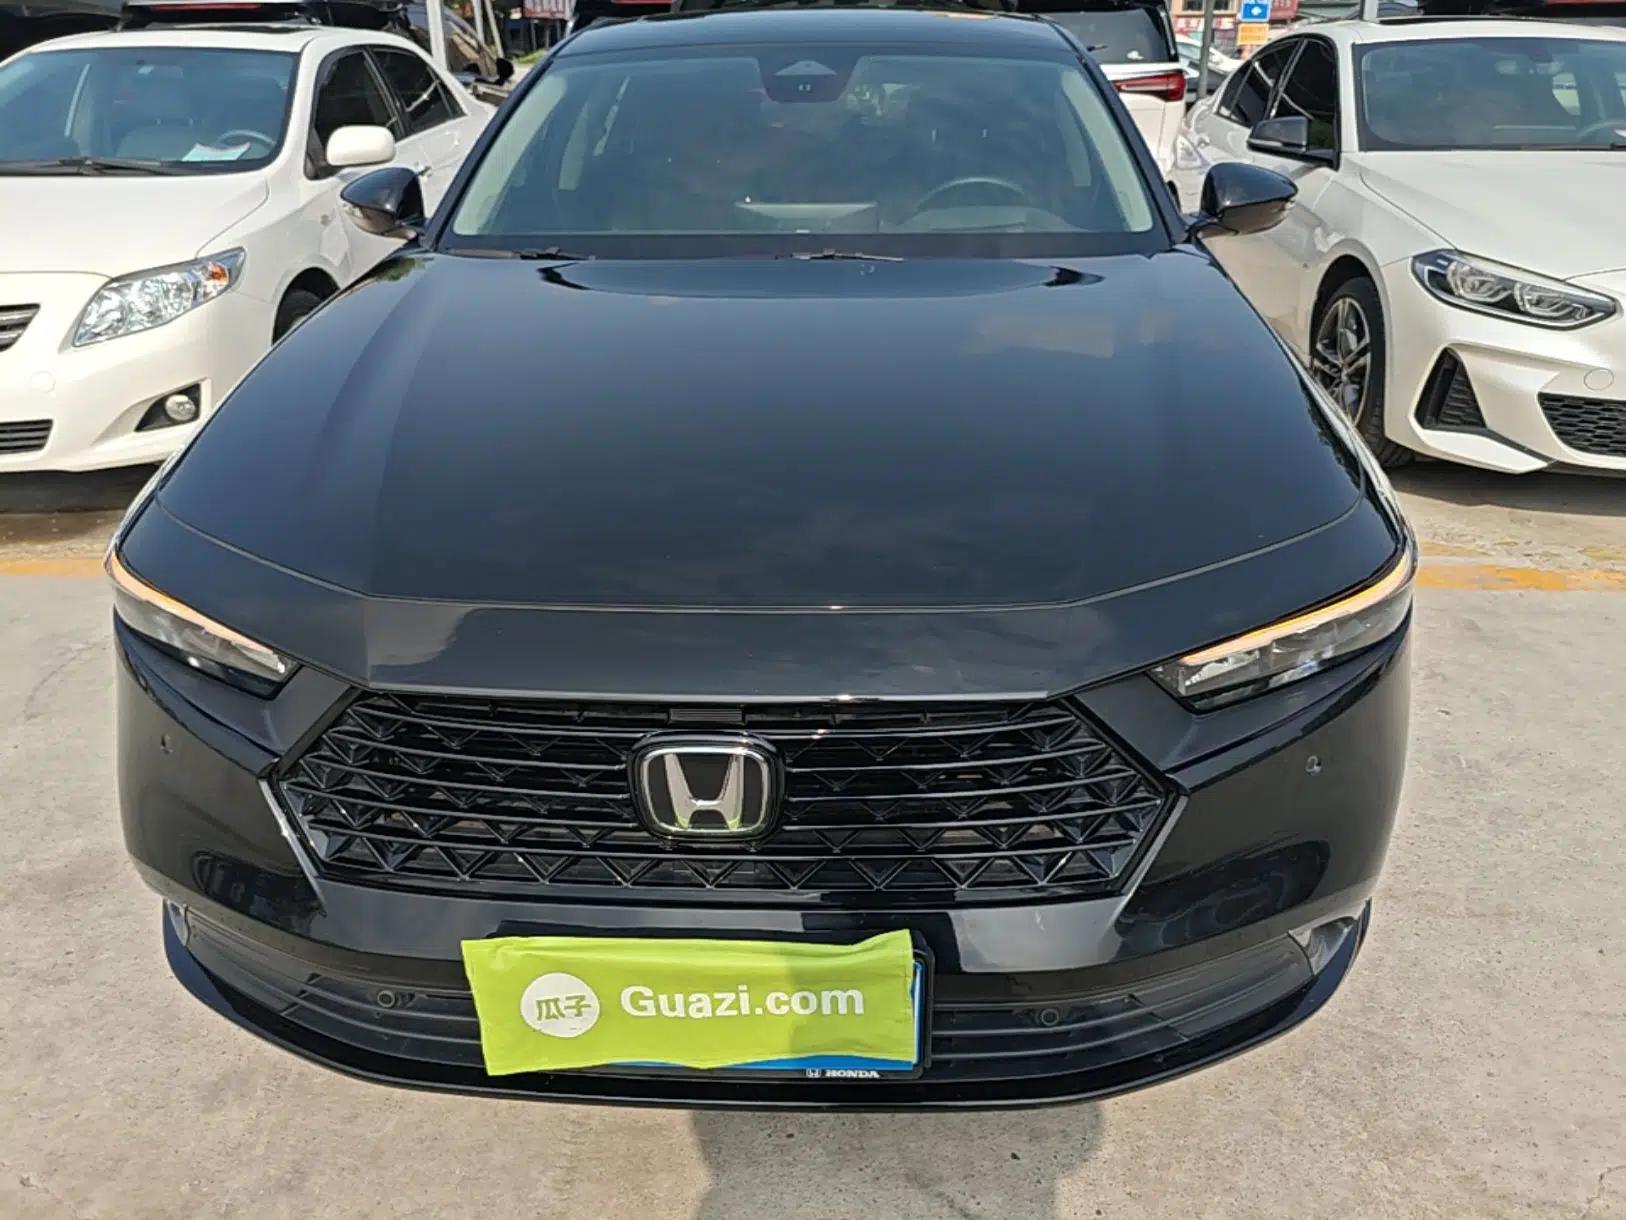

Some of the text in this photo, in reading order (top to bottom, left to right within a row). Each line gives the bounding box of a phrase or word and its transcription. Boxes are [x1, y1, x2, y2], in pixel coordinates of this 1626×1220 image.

[535, 994, 592, 1021] 瓜子
[620, 984, 865, 1019] Guazi.com
[825, 1069, 880, 1079] HONDA
